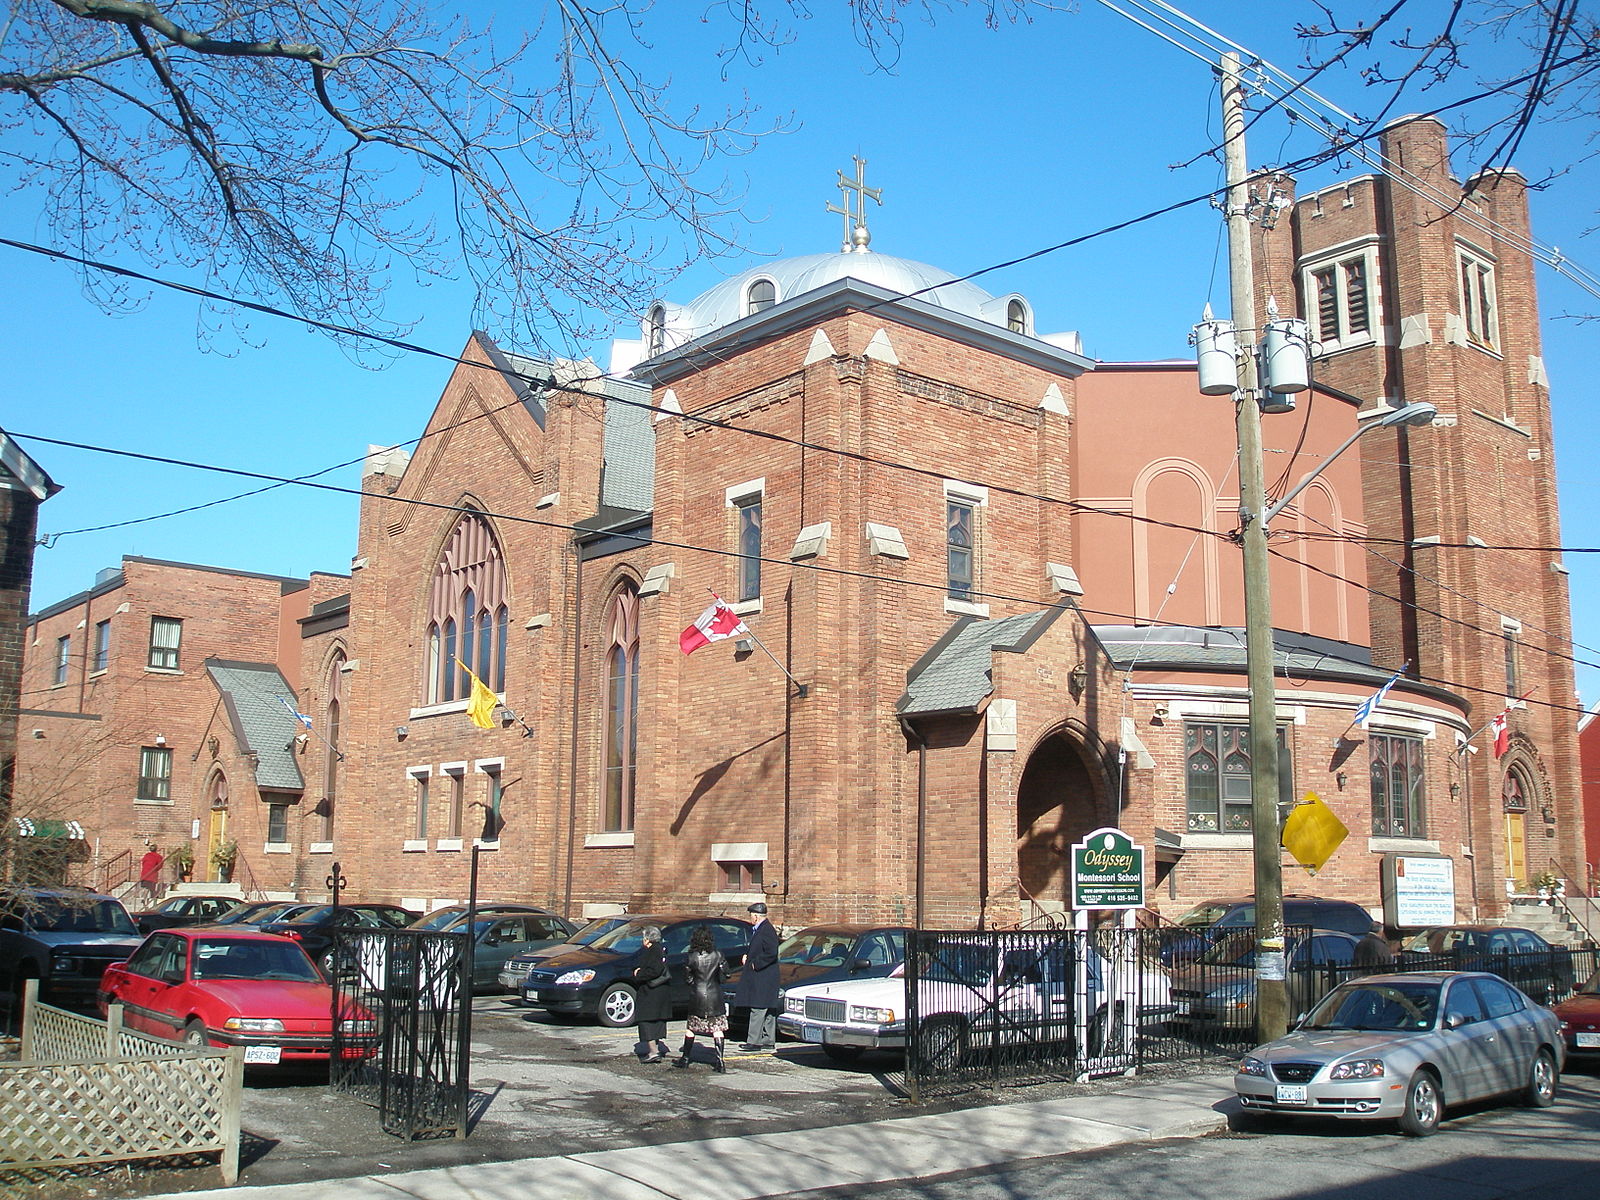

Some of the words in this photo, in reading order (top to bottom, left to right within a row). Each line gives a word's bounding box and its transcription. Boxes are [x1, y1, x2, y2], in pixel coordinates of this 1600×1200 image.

[1084, 848, 1133, 872] Odyssey
[1077, 873, 1116, 882] Montessori
[1117, 873, 1140, 882] School
